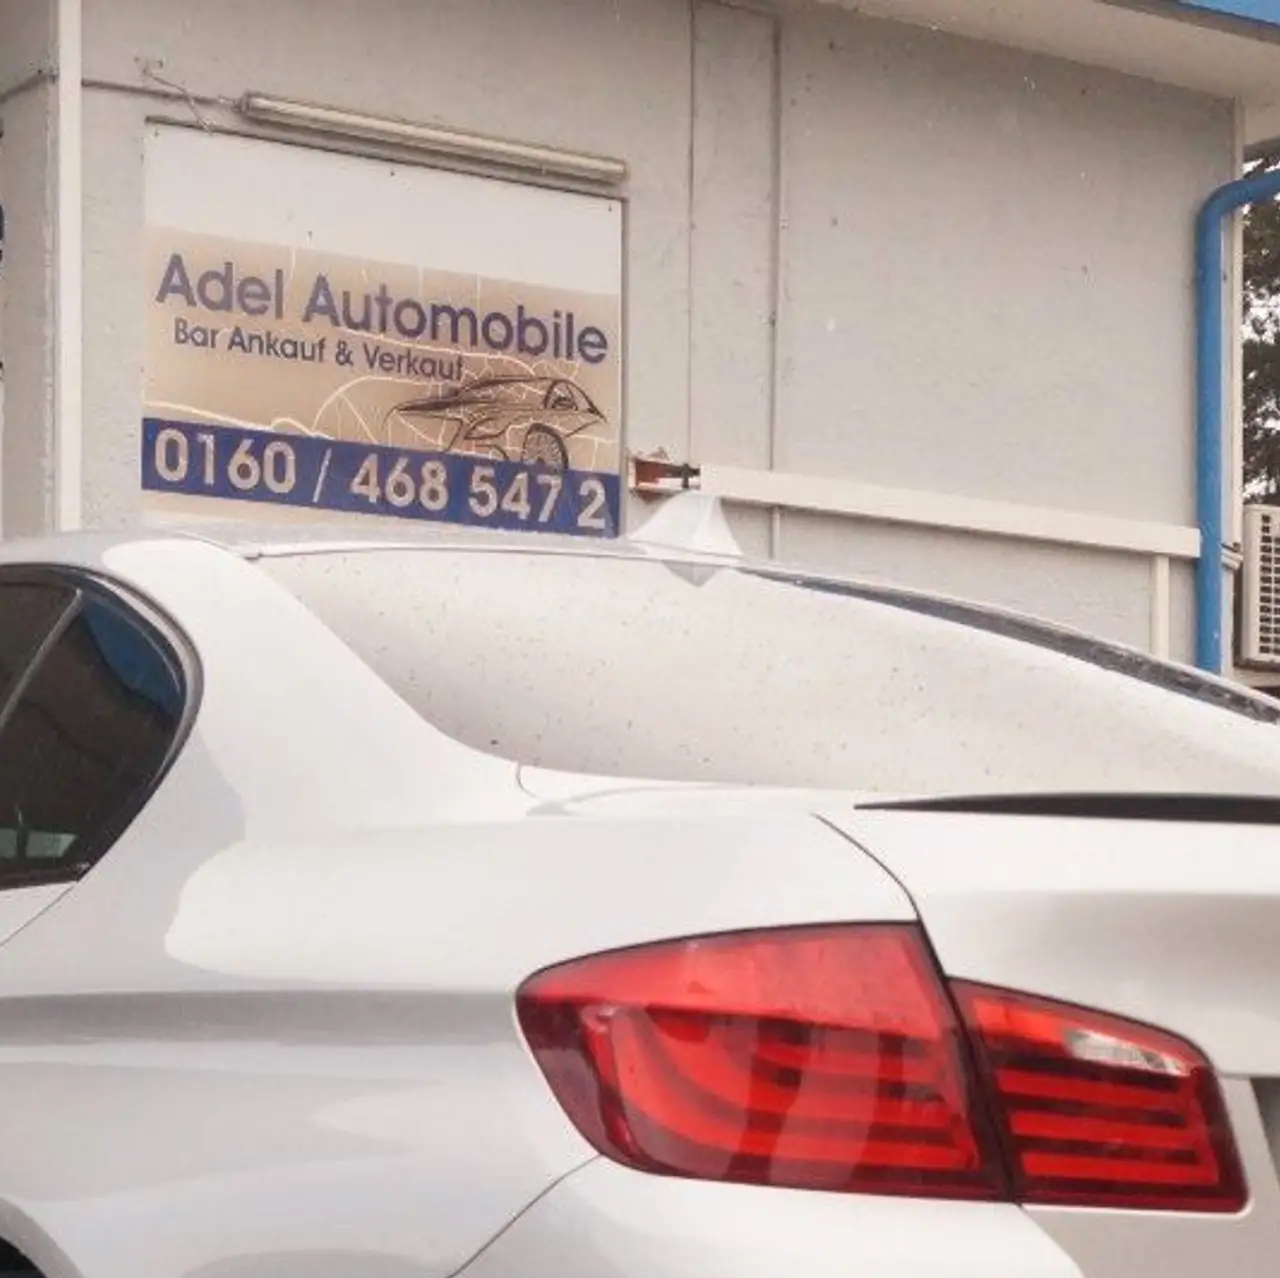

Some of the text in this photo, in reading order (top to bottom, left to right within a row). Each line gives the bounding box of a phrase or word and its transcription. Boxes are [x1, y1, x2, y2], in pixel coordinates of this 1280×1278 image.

[155, 253, 608, 364] Adel Automobile
[174, 316, 464, 381] Bar Ankauf & Verkauf
[154, 428, 607, 530] 0160 / 468 547 2
